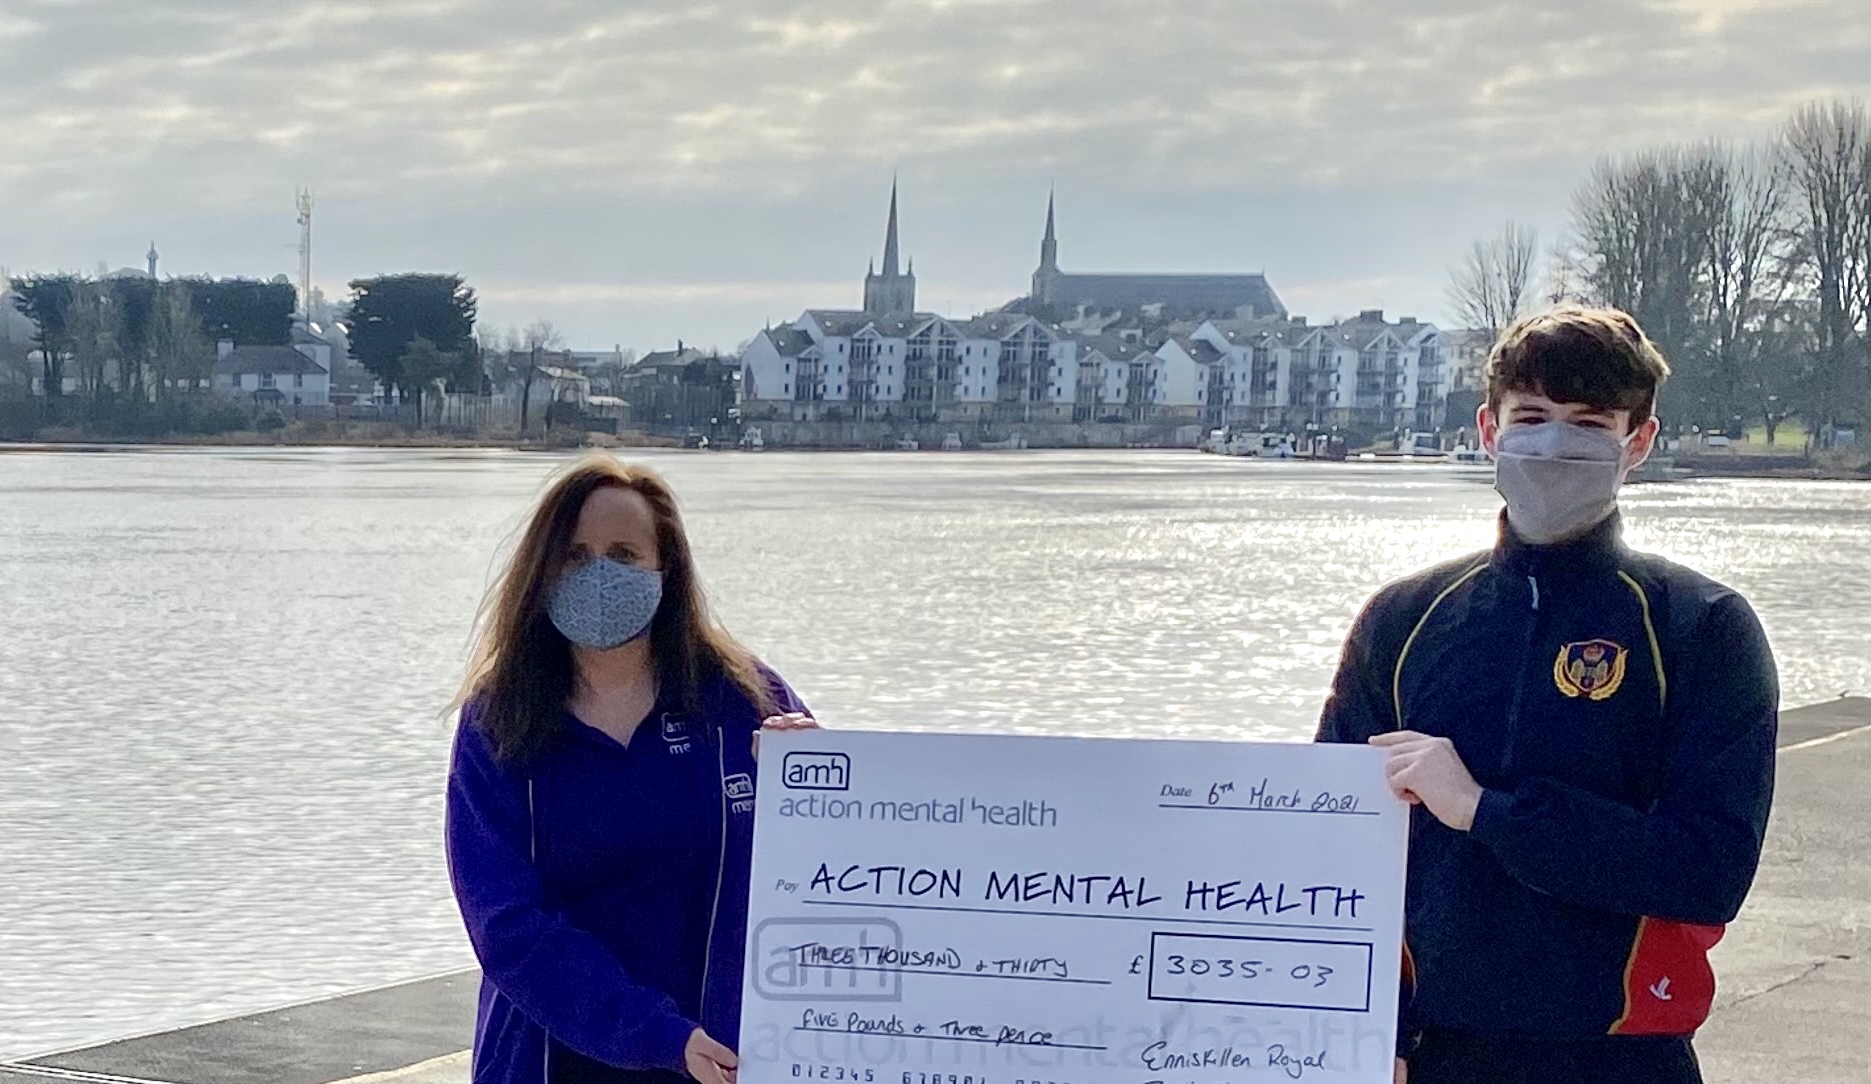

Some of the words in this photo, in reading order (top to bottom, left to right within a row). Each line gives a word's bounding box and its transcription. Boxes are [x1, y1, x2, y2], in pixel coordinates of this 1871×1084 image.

[786, 756, 845, 787] amh
[1159, 783, 1193, 798] Date
[778, 794, 862, 820] action
[869, 797, 964, 824] mental
[970, 796, 1058, 828] health
[810, 862, 962, 899] ACTION
[985, 871, 1162, 909] MENTAL
[1184, 878, 1366, 919] HEALTH
[859, 945, 962, 970] THOUSAND
[1128, 954, 1143, 976] £
[791, 1063, 875, 1083] 012345
[1266, 1043, 1327, 1080] Royal
